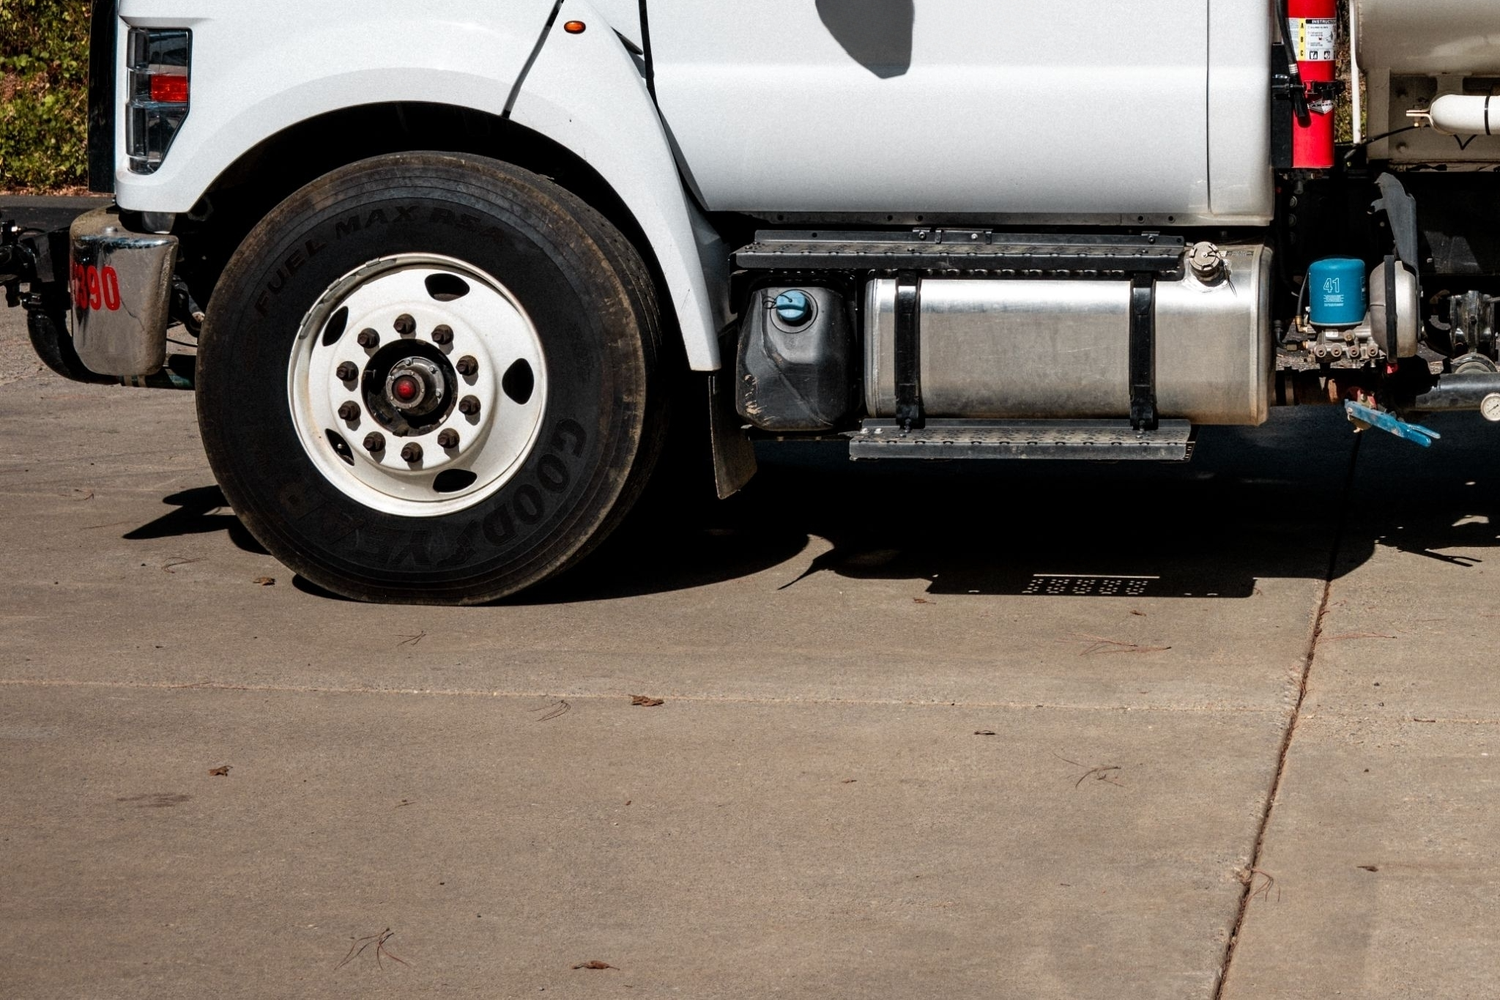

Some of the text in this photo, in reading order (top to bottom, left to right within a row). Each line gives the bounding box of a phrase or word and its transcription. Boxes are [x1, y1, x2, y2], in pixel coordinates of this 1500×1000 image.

[73, 261, 121, 311] 390
[252, 204, 507, 322] FUEL MAX RSA
[1323, 277, 1340, 293] 41
